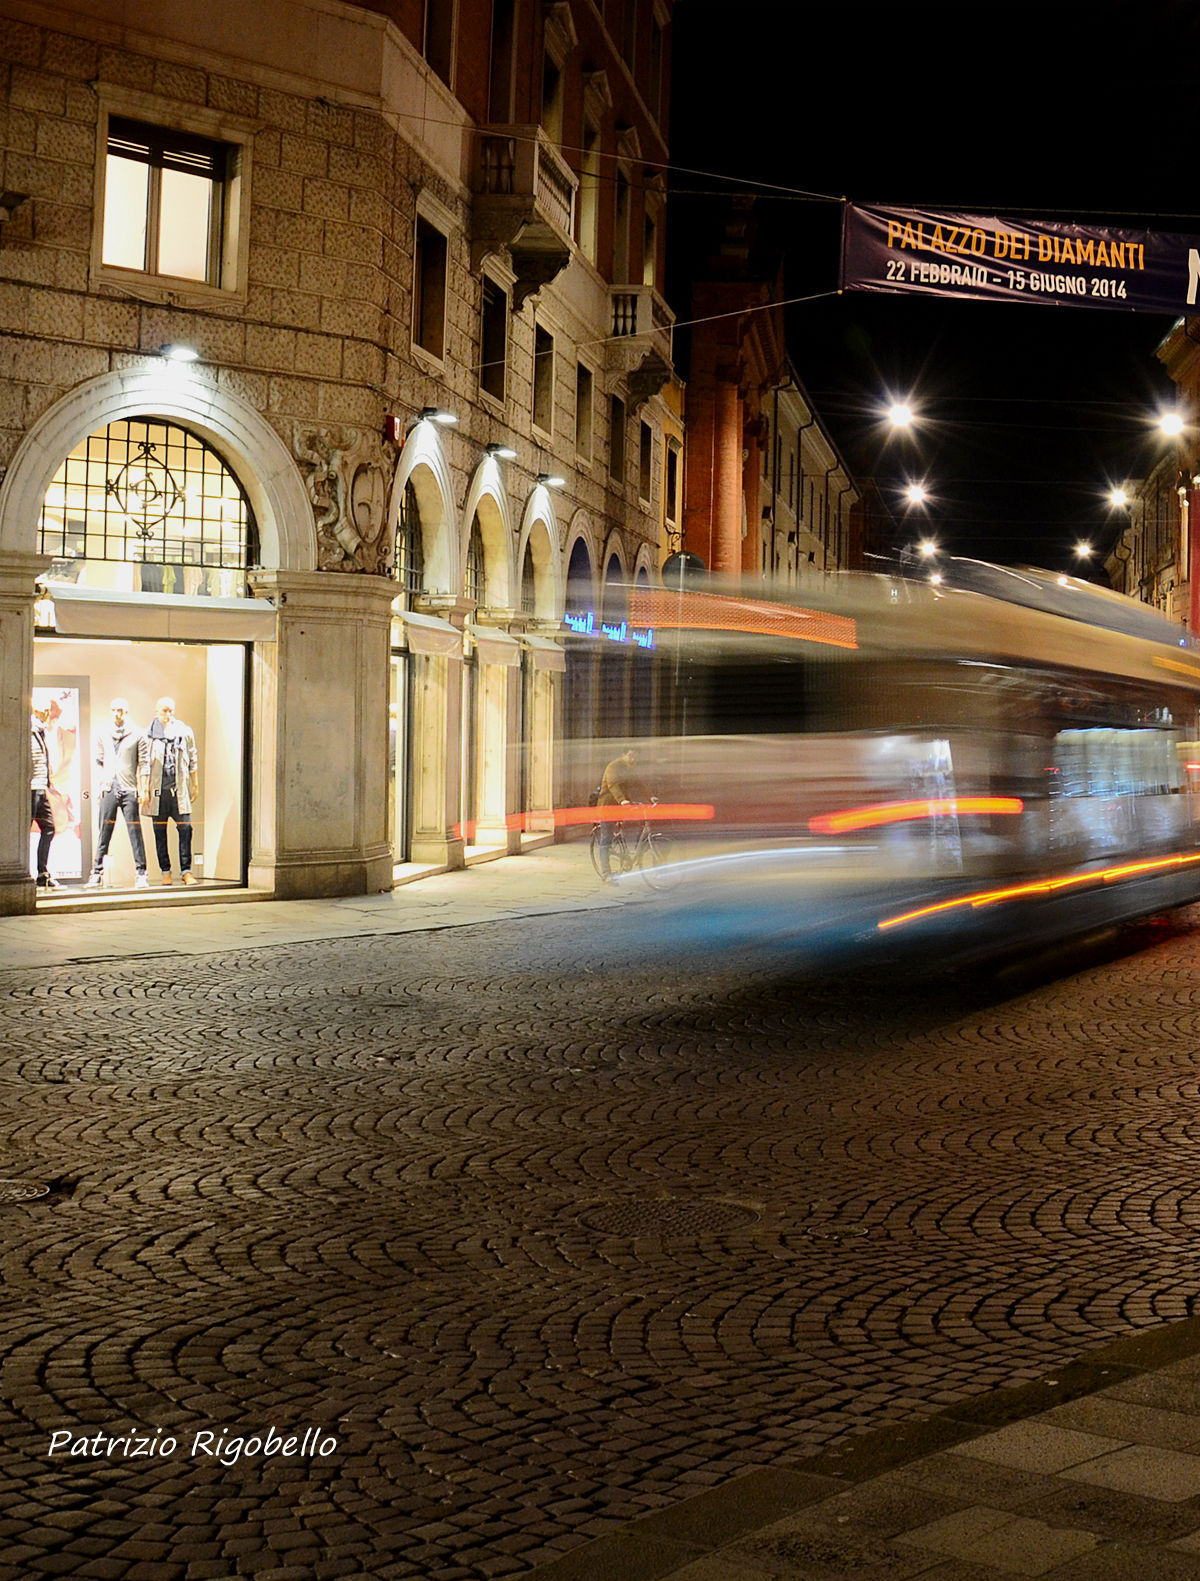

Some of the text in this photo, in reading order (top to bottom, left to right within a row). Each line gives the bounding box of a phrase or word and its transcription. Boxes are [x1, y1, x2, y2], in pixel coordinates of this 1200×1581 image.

[887, 220, 1145, 270] PALAZZO DEI DIAMANTI
[886, 260, 905, 283] 22
[910, 262, 988, 288] FEBBRAIO
[1007, 269, 1026, 291] 15
[1029, 271, 1087, 296] GIUGNO
[1091, 277, 1127, 300] 2014
